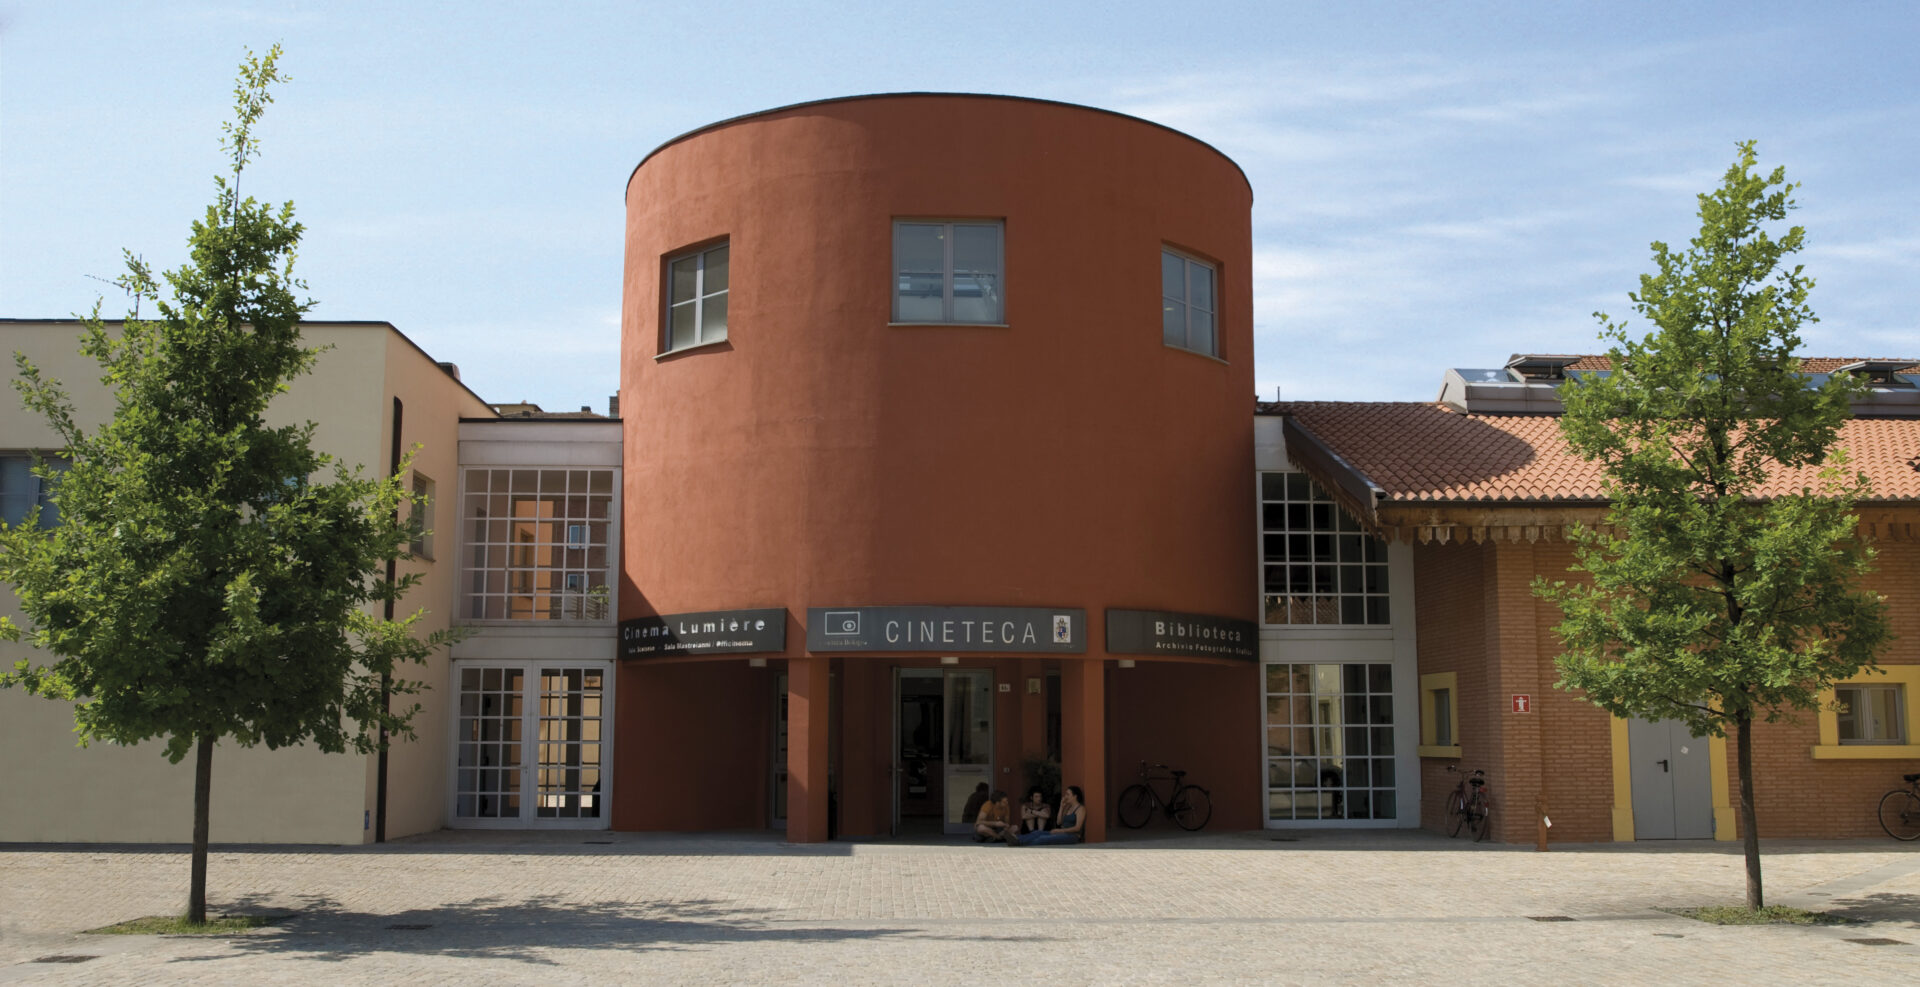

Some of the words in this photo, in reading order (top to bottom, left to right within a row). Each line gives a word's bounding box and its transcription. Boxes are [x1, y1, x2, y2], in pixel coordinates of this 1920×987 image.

[624, 626, 669, 640] Cinema
[680, 618, 765, 634] Lumière
[886, 621, 1037, 643] CINETECA
[1155, 621, 1241, 641] Biblioteca
